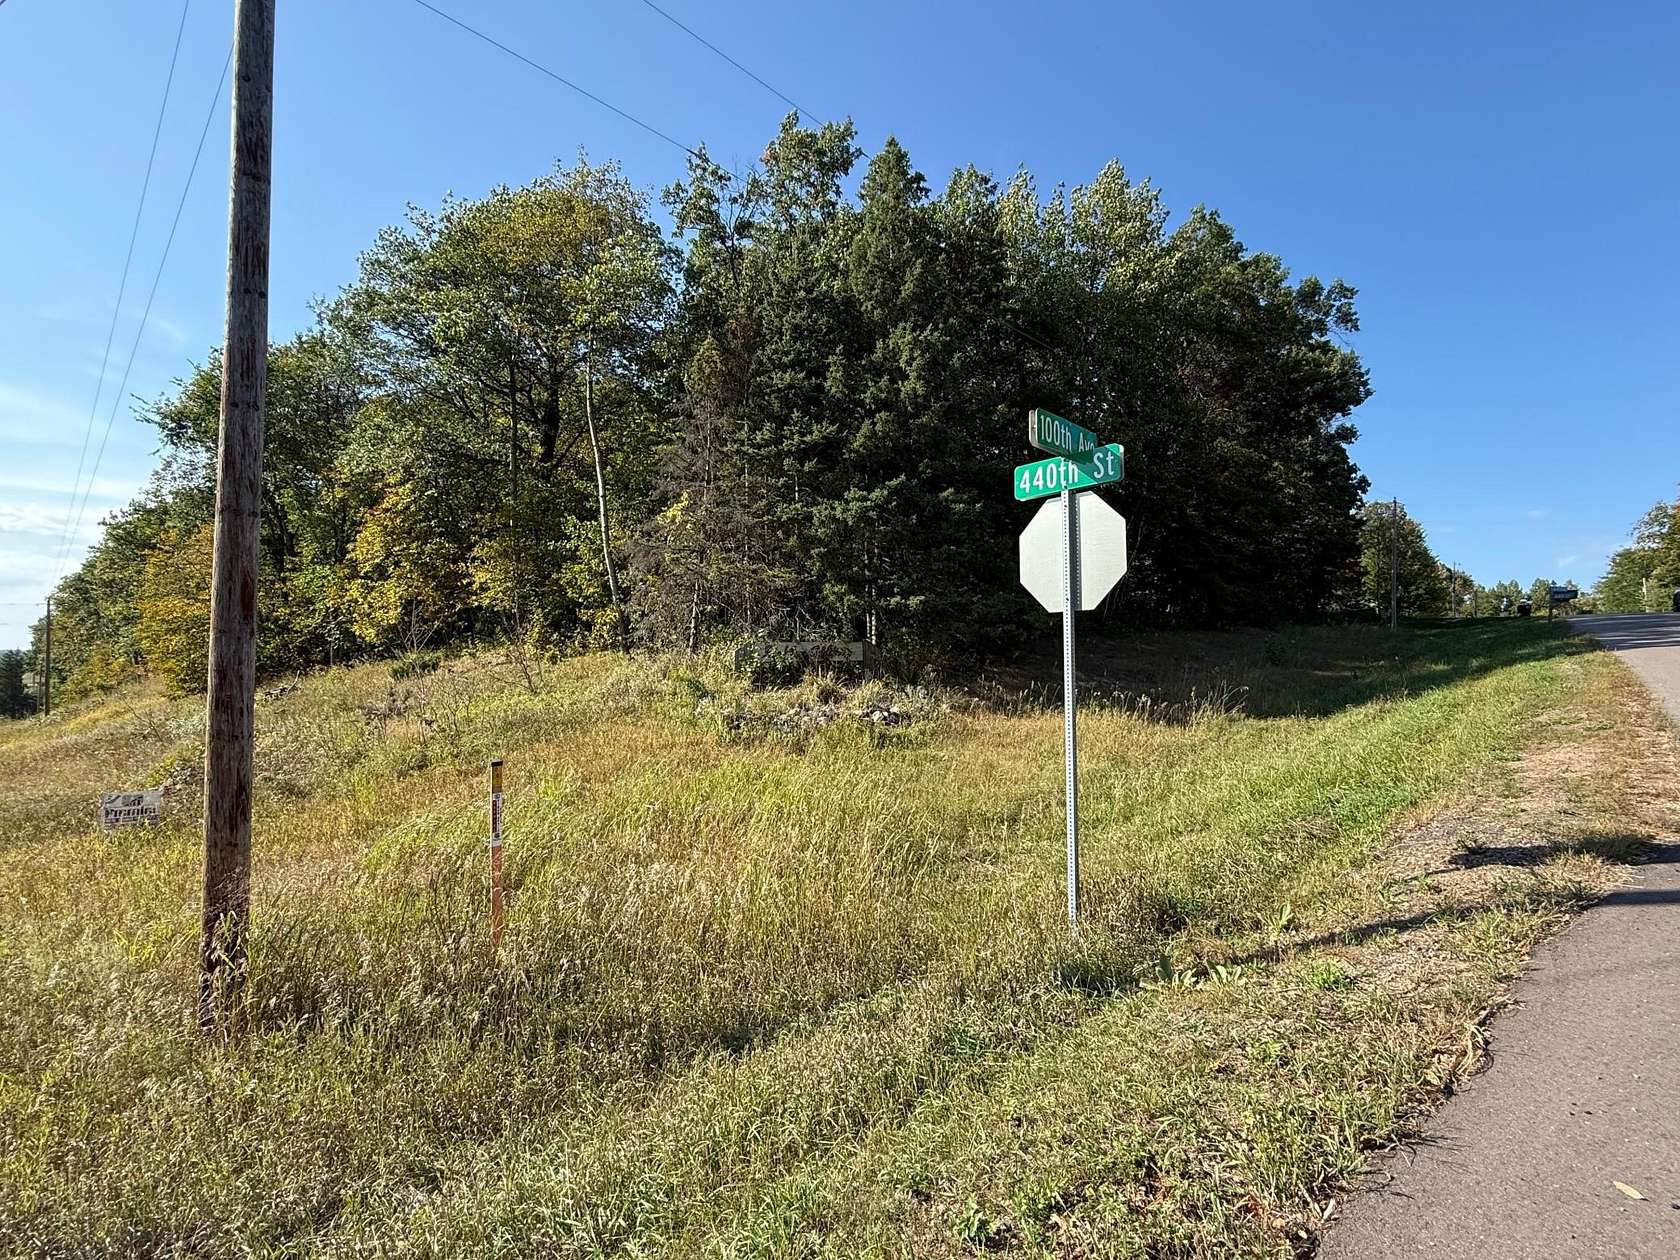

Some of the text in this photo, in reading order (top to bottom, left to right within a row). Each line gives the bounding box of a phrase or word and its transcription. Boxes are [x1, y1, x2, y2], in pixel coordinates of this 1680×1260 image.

[1040, 415, 1072, 454] 100th
[1019, 451, 1115, 493] 440th St
